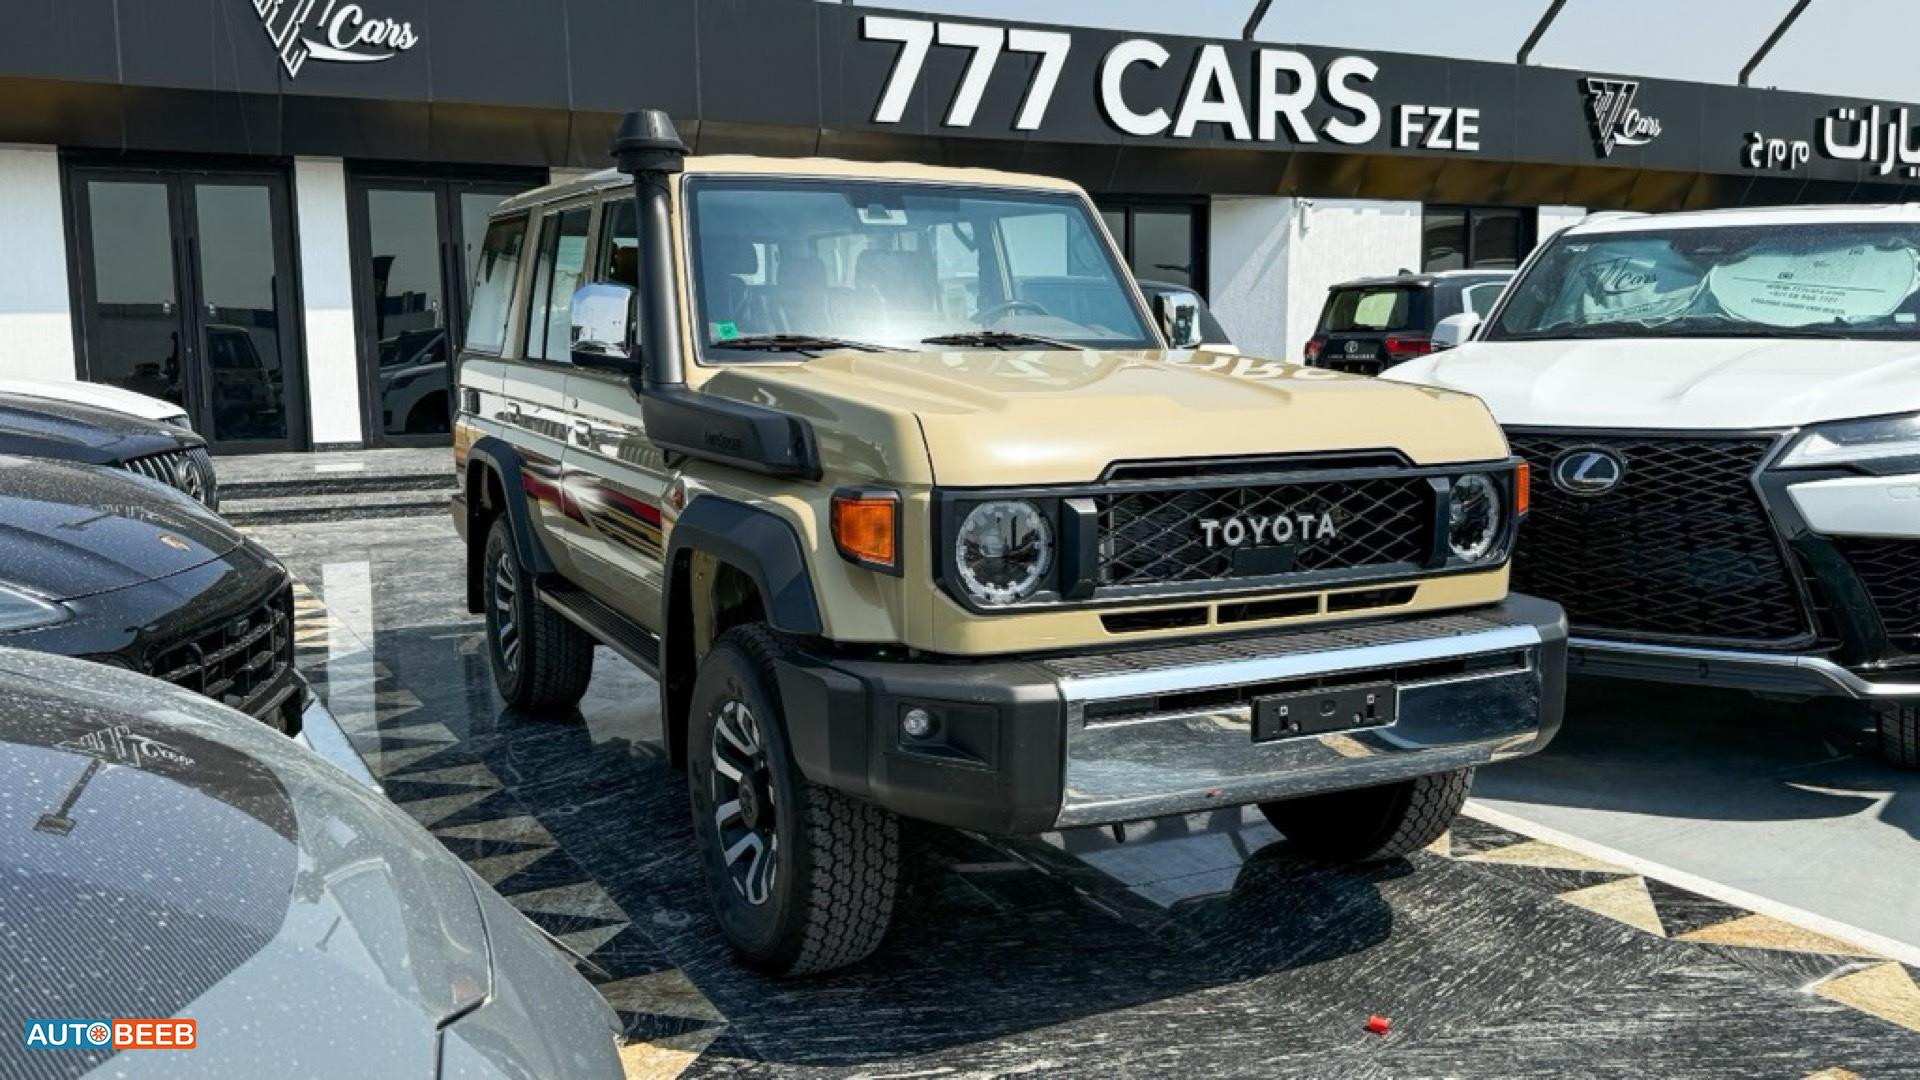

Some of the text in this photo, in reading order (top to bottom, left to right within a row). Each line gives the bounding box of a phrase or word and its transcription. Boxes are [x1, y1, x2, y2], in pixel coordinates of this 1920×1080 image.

[327, 3, 419, 50] Cars
[863, 15, 1480, 151] 777 CARS FZE
[1624, 108, 1662, 138] Cars
[1200, 511, 1336, 547] TOYOTA
